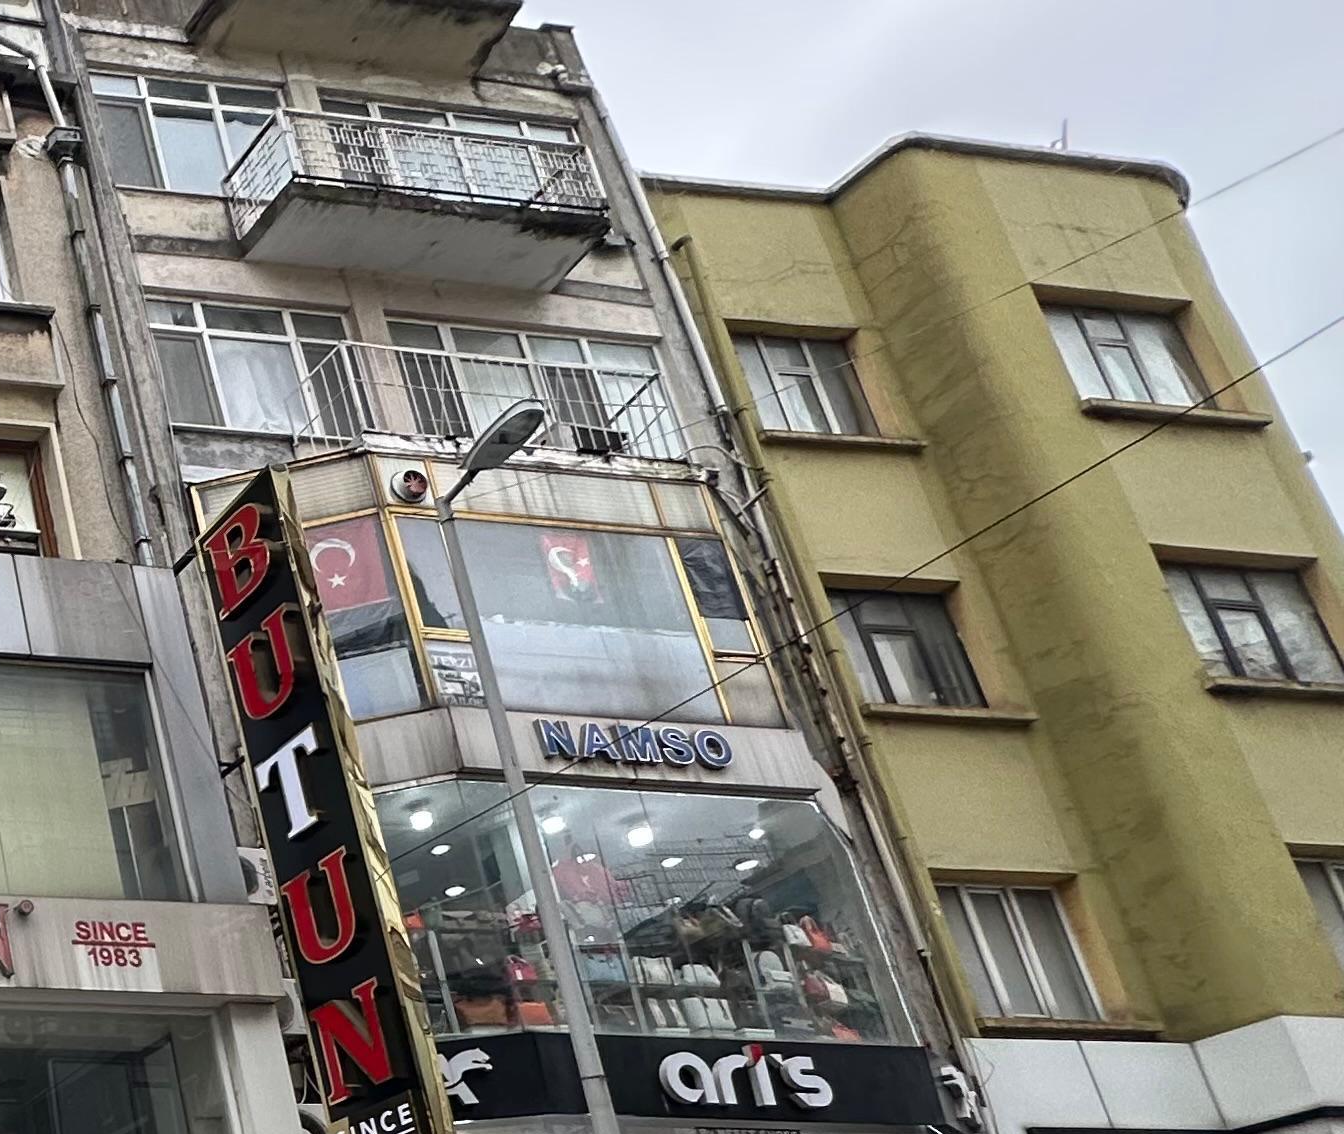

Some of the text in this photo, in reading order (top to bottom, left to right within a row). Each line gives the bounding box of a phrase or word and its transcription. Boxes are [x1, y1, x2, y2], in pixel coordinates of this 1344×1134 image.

[535, 719, 733, 768] NAMSO
[203, 502, 393, 1107] BUTUN
[75, 920, 148, 943] SINCE
[88, 948, 143, 968] 1983
